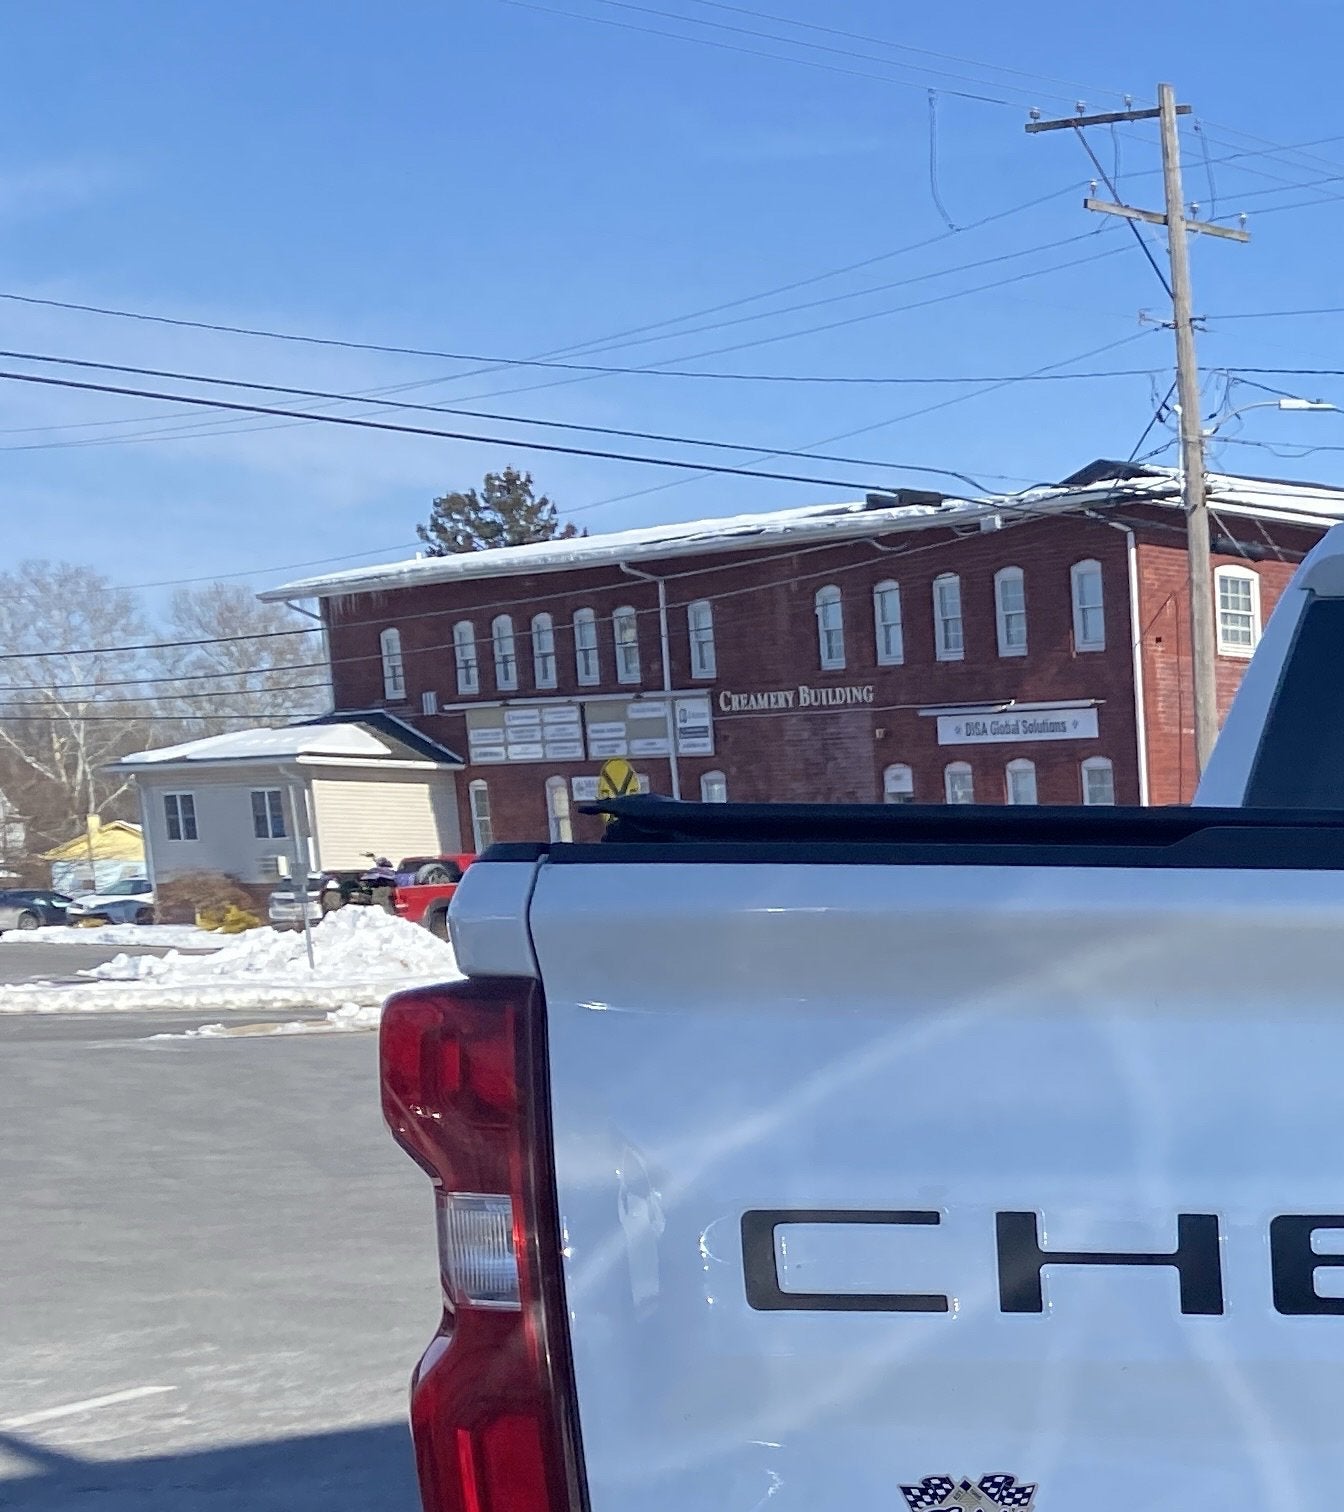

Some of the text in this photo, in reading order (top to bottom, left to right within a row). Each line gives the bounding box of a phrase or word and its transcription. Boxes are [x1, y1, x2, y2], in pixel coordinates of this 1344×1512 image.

[719, 685, 874, 712] CREAMERY BUILDING
[965, 719, 1067, 736] DISA Global Solutions
